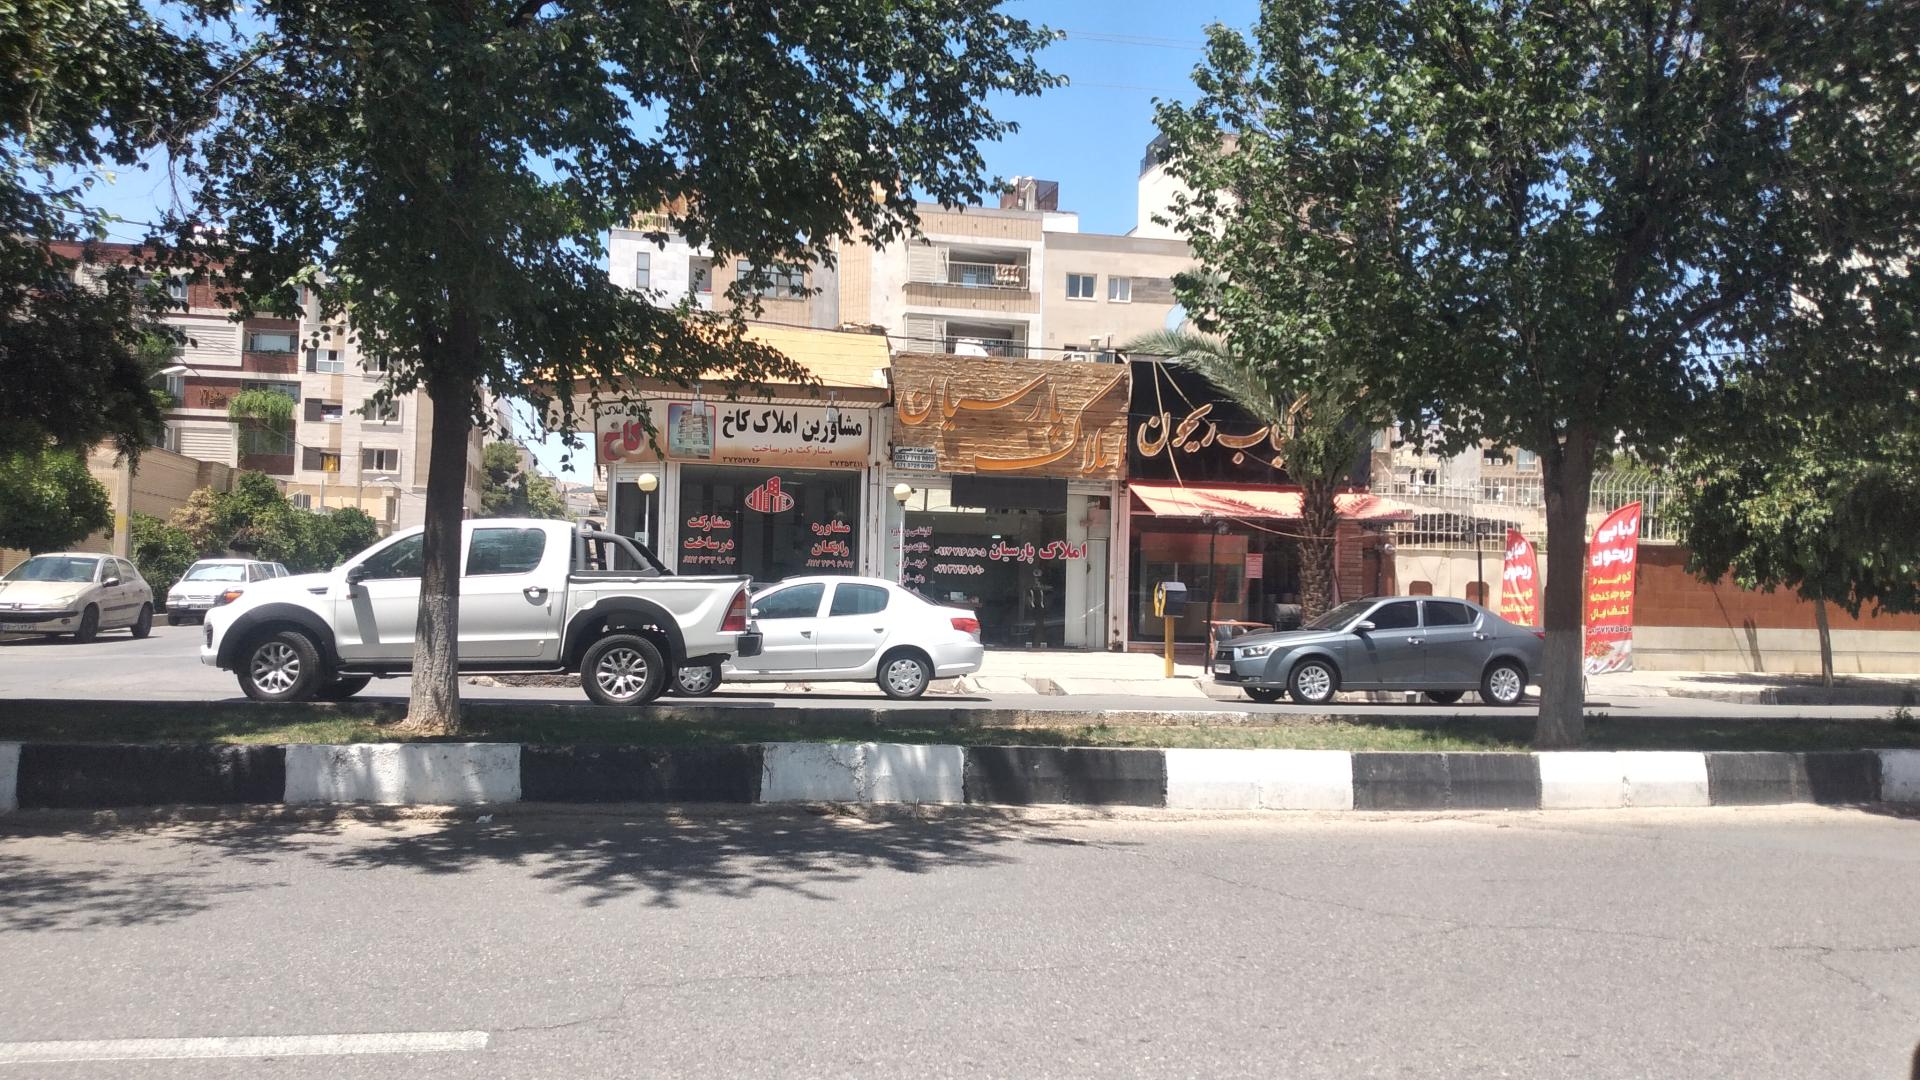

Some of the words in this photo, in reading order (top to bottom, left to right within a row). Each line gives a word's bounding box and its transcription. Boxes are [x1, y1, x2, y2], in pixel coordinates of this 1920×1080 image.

[898, 372, 1064, 441] پارسیان
[722, 408, 750, 438] کاخ
[753, 409, 798, 434] املاک
[802, 412, 863, 443] مشاورین
[974, 369, 1126, 474] املاک
[1137, 403, 1216, 457] ریحون
[604, 420, 642, 461] کاخ
[751, 444, 780, 453] ساخت
[783, 447, 793, 455] در
[796, 445, 833, 456] مشارکت
[687, 515, 731, 531] مشارکت
[811, 520, 850, 536] مشاوره
[1598, 517, 1637, 543] کبابی
[683, 536, 719, 549] ساخت
[811, 540, 849, 557] رایگان
[989, 541, 1035, 564] پارسیان
[1039, 541, 1088, 560] املاک
[1592, 547, 1634, 567] ریحون
